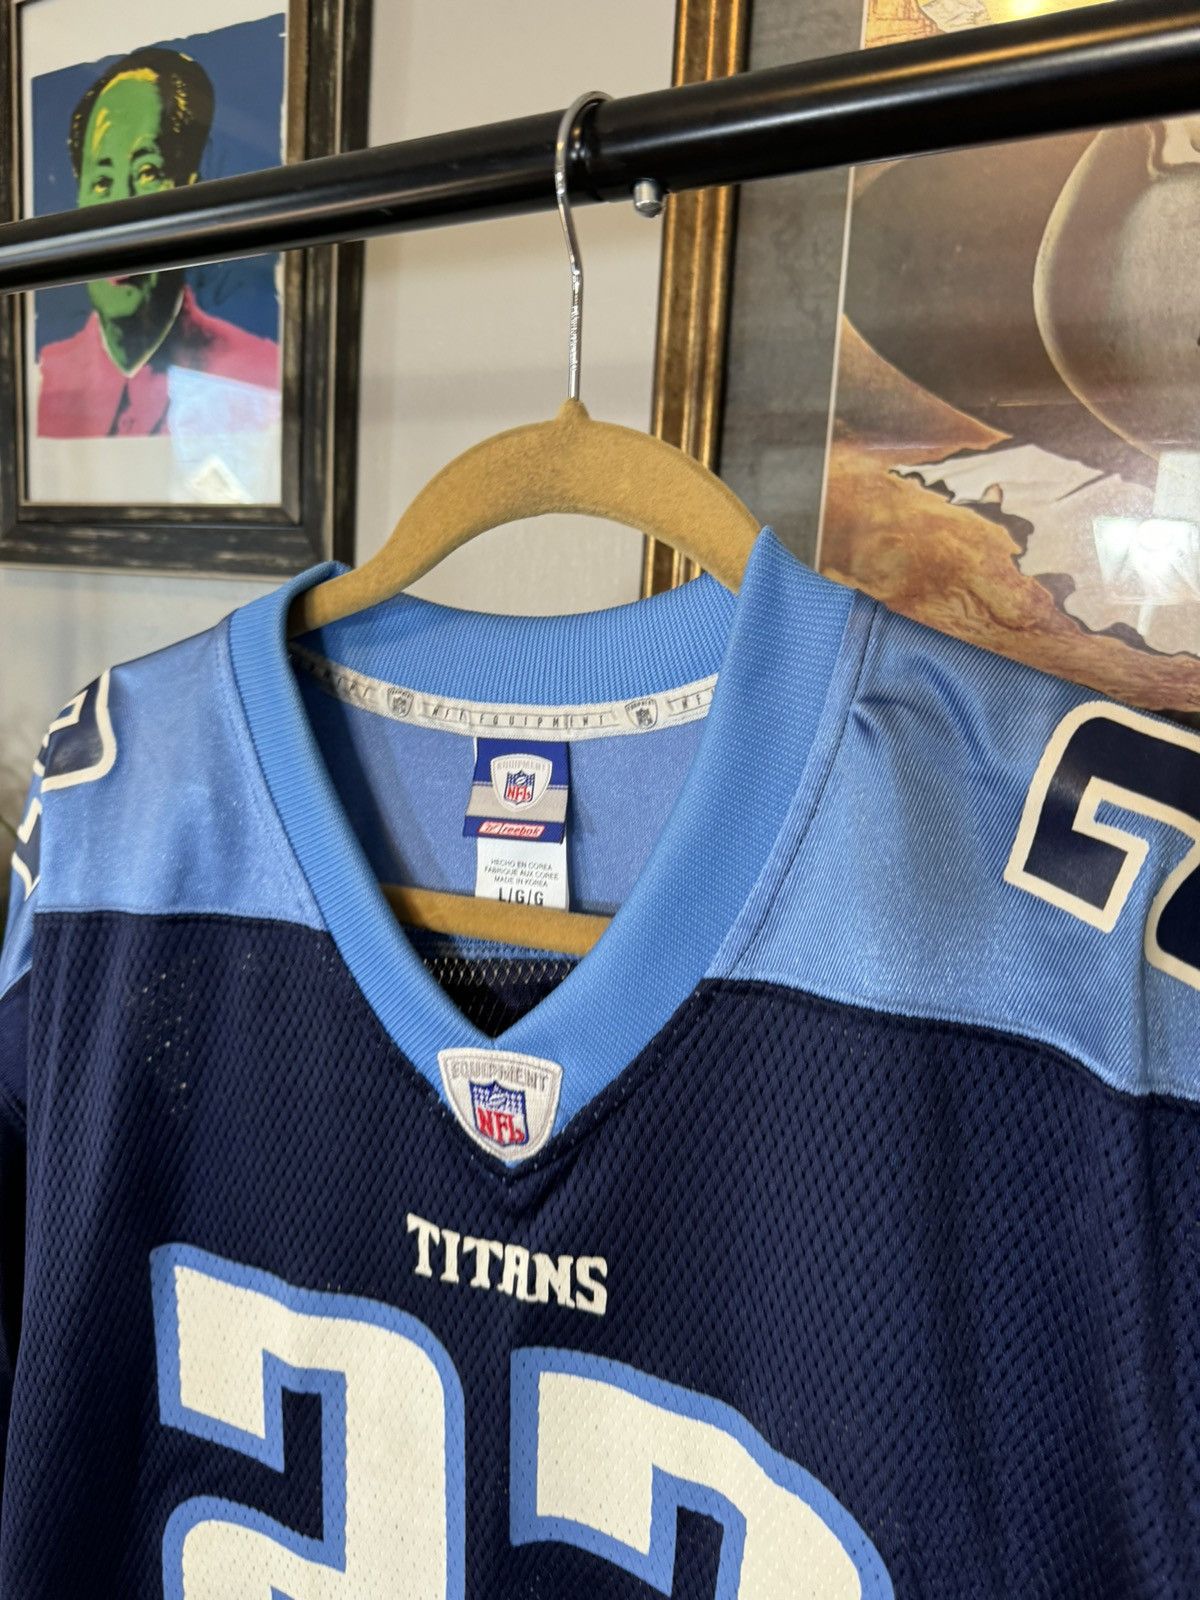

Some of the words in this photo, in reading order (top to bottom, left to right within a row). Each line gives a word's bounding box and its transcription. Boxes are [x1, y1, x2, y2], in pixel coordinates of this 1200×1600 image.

[507, 785, 532, 801] NFL
[494, 875, 514, 884] MADE
[499, 887, 545, 906] L/G/G
[450, 1059, 550, 1092] EQUIPMENT
[476, 1106, 526, 1147] NFL
[406, 1212, 609, 1317] TITANS
